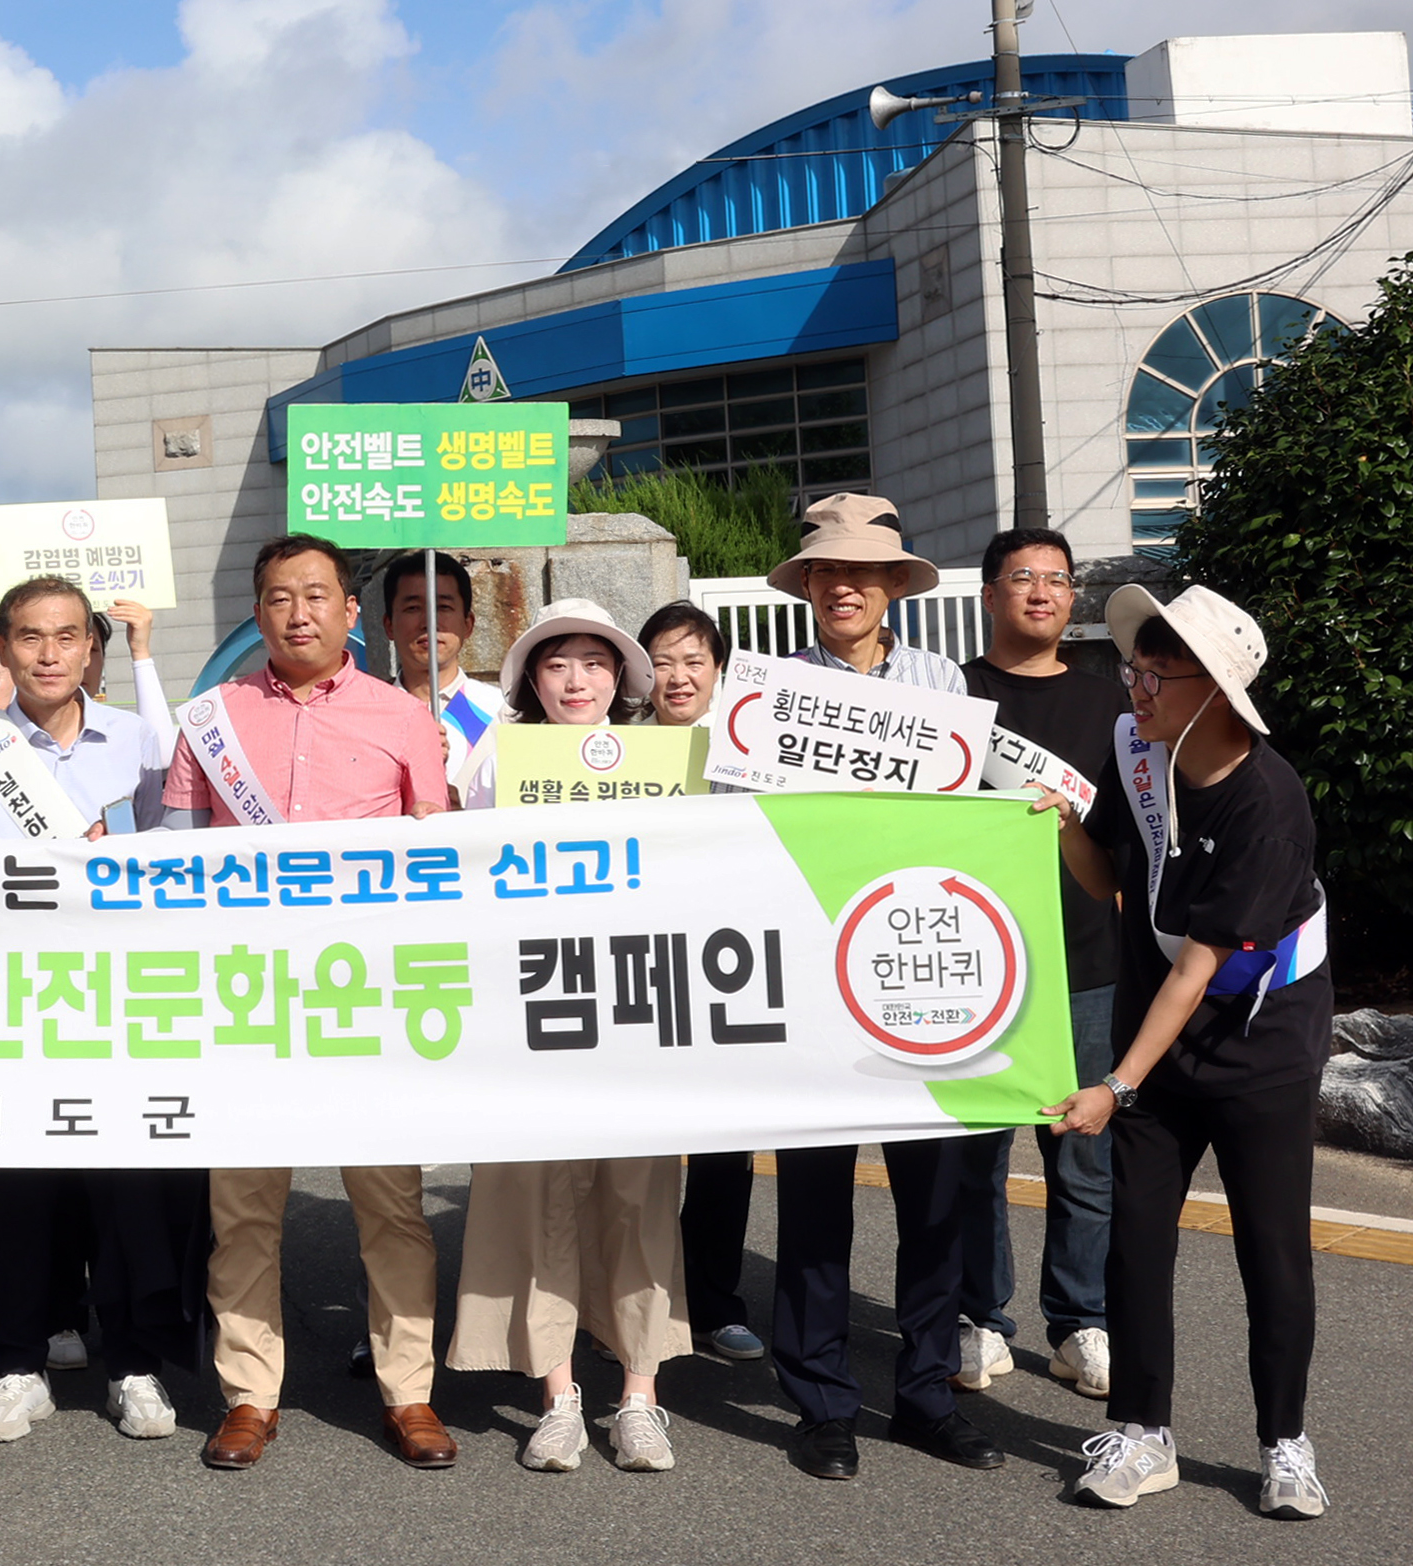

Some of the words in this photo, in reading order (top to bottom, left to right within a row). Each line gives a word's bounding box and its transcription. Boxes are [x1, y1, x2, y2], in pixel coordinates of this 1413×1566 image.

[471, 368, 492, 392] 中
[301, 431, 425, 470] 안전벨트
[436, 430, 556, 470] 생명벨트
[301, 482, 425, 521] 안전속도
[436, 481, 555, 521] 생명속도
[24, 548, 81, 570] 감염병
[85, 545, 142, 567] 예방의
[90, 569, 144, 591] 손씻기
[734, 662, 767, 685] 안전
[772, 688, 938, 751] 횡단보도에서는
[201, 726, 226, 758] 매월
[221, 755, 248, 799] 4일은
[242, 794, 273, 825] 안전
[712, 764, 742, 778] Jindo
[777, 732, 919, 791] 일단정지
[519, 779, 563, 804] 생활
[570, 780, 589, 802] 속
[1133, 758, 1157, 809] 4일은
[86, 847, 463, 911] 안전신문고로
[488, 837, 641, 899] 신고!
[887, 905, 961, 945] 안전
[519, 927, 787, 1050] 캠페인
[871, 950, 982, 991] 한바퀴
[882, 1003, 911, 1011] 대한민국
